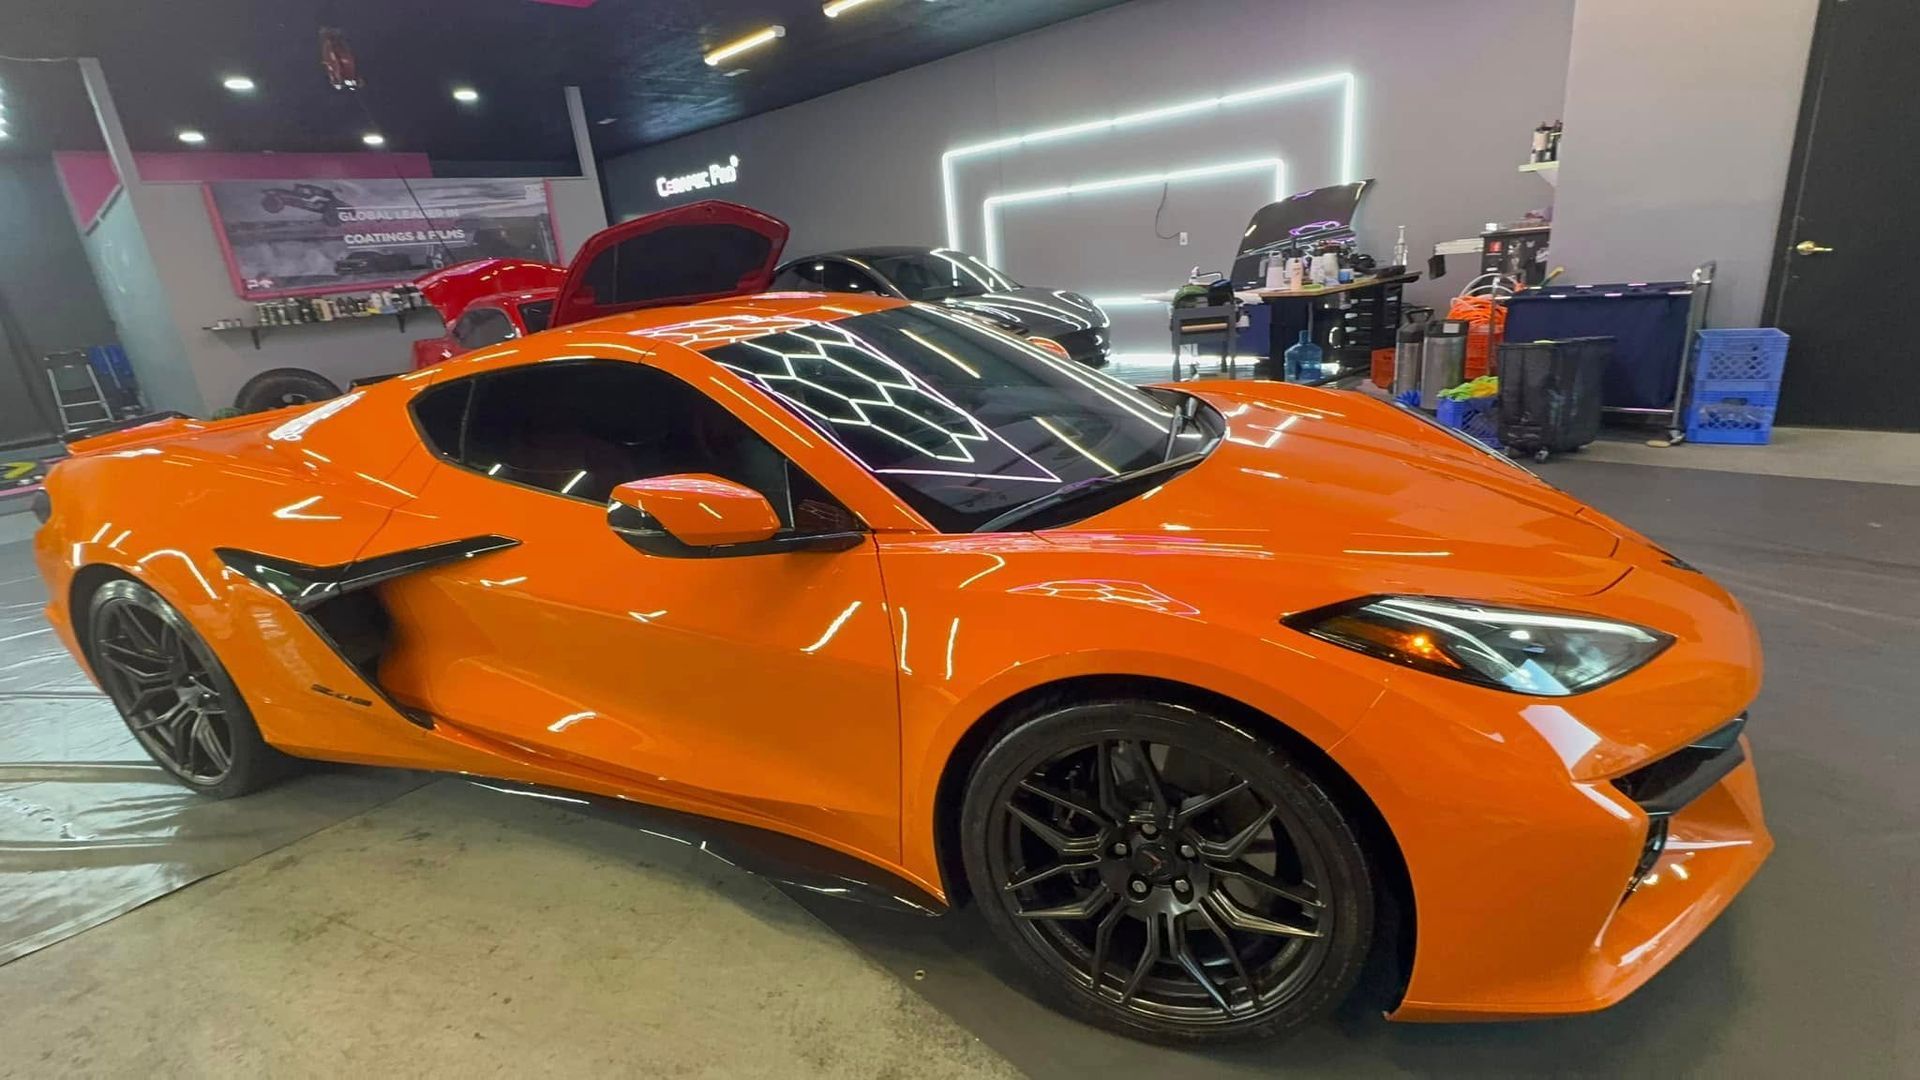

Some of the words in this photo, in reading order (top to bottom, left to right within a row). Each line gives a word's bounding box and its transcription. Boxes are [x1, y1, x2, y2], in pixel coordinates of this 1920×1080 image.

[338, 210, 394, 222] GLOBAL
[395, 208, 445, 220] LEADER
[343, 232, 415, 245] COATINGS
[416, 230, 427, 241] &
[428, 229, 466, 240] FILMS
